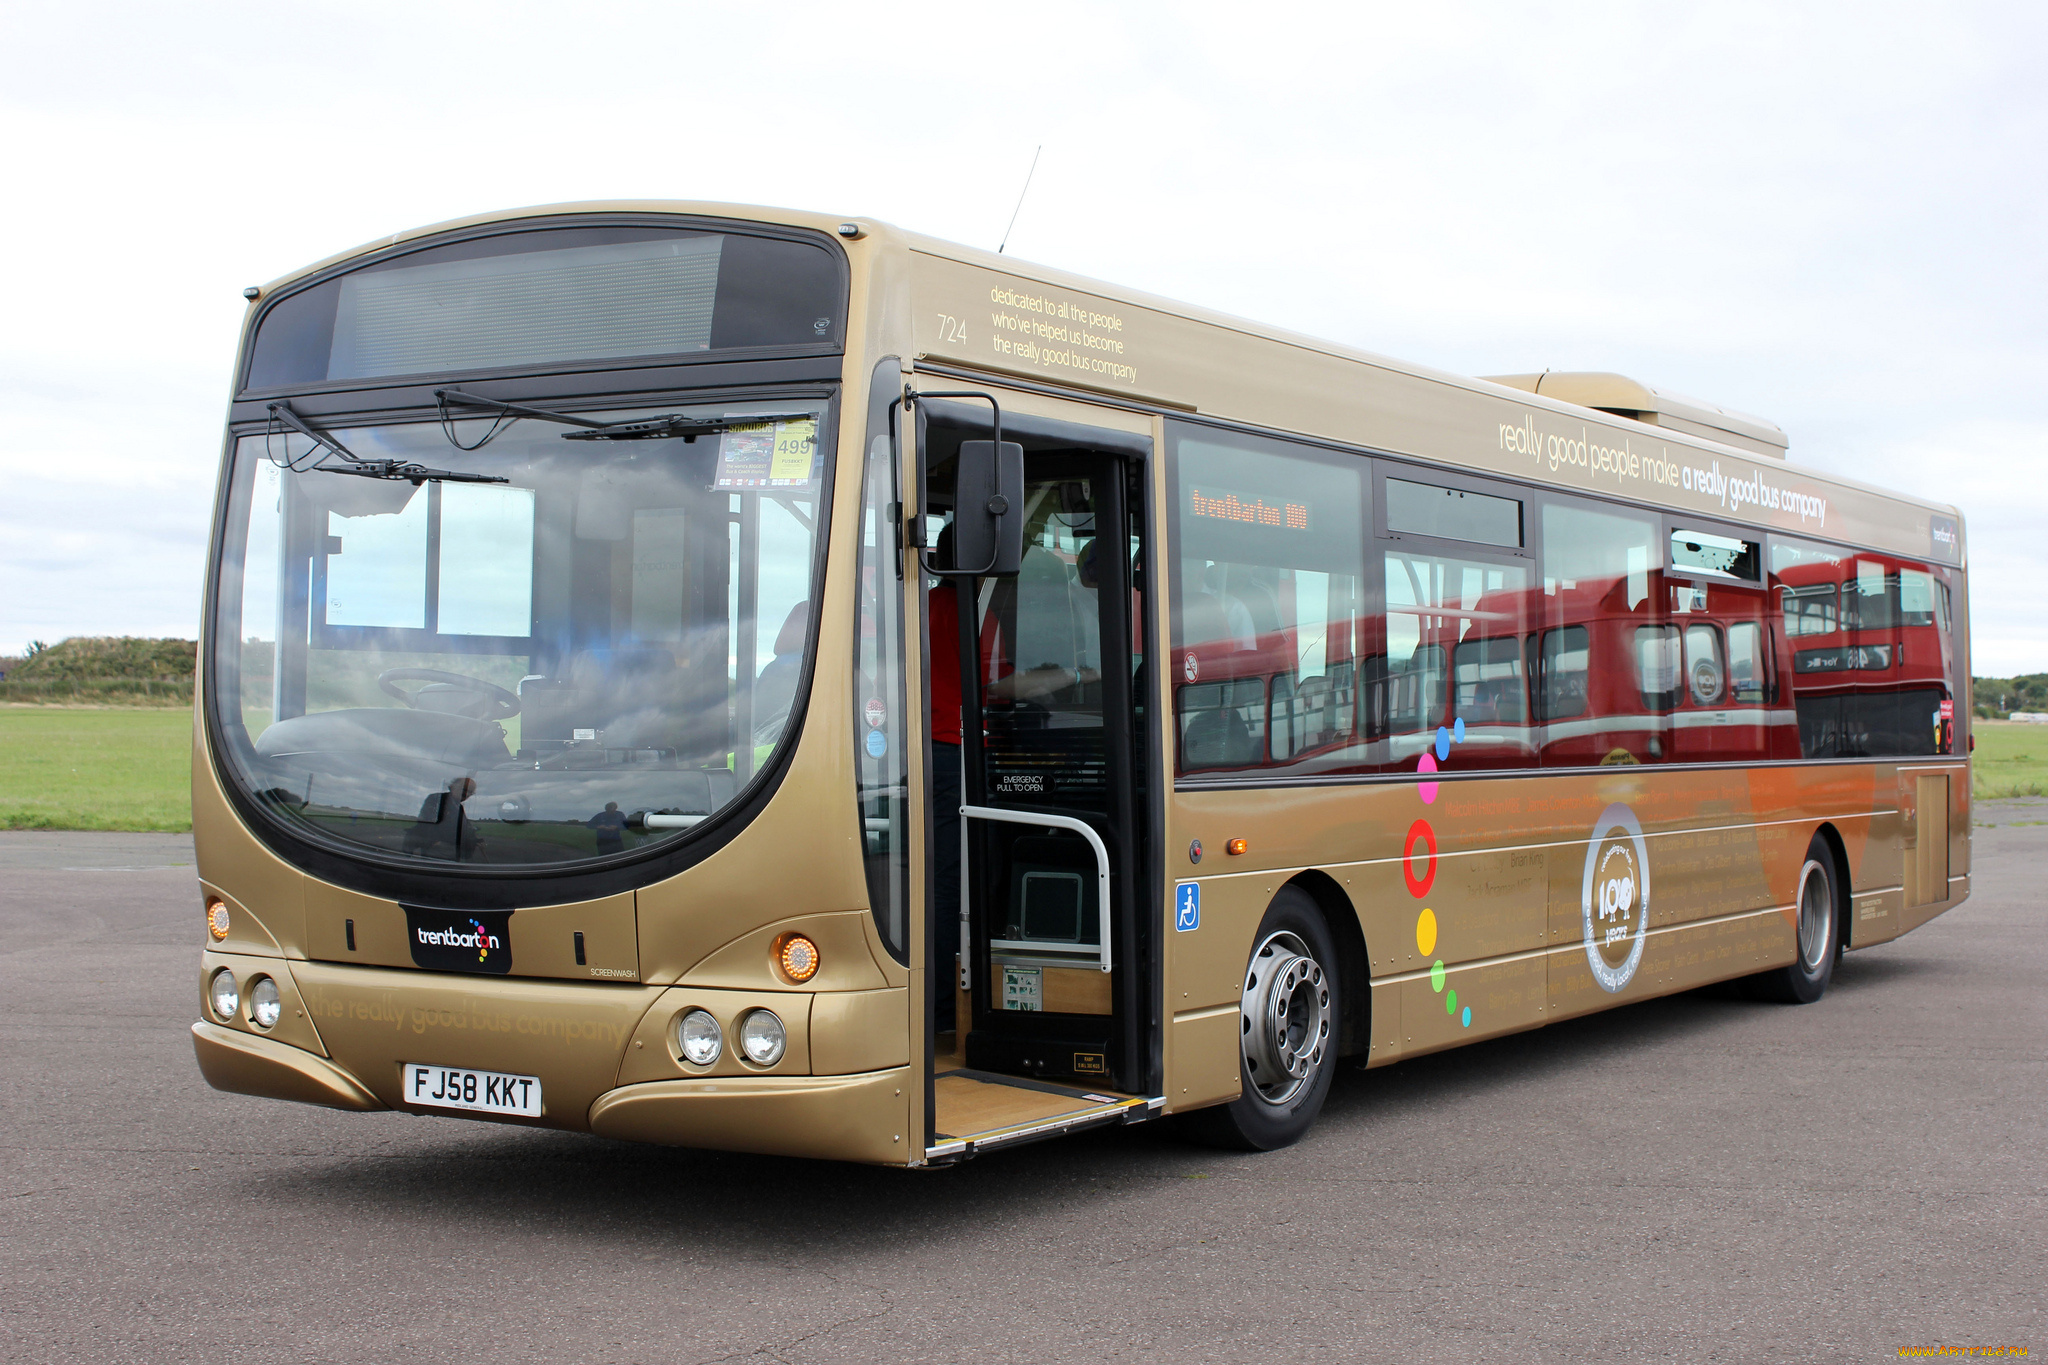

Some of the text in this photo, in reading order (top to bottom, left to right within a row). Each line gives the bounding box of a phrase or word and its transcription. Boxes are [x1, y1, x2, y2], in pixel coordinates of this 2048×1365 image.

[991, 285, 1122, 332] dedicated to all the people
[937, 313, 968, 345] 724
[991, 311, 1124, 354] who've helped us become
[993, 334, 1137, 384] the really good bus company
[778, 440, 810, 455] 499
[1499, 413, 1827, 527] really good people make a really good bus company
[1192, 489, 1307, 529] trentbarton 100
[996, 784, 1044, 792] PULL TO OPEN
[1003, 775, 1044, 784] EMERGENCY
[1511, 852, 1527, 868] Brian
[1528, 850, 1544, 869] King
[417, 926, 500, 949] trentbarton
[1606, 925, 1628, 948] years
[590, 967, 636, 978] SCREENWASH
[1602, 971, 1617, 991] really
[310, 987, 629, 1051] the really good bus company
[415, 1068, 533, 1109] FJ58 KKT
